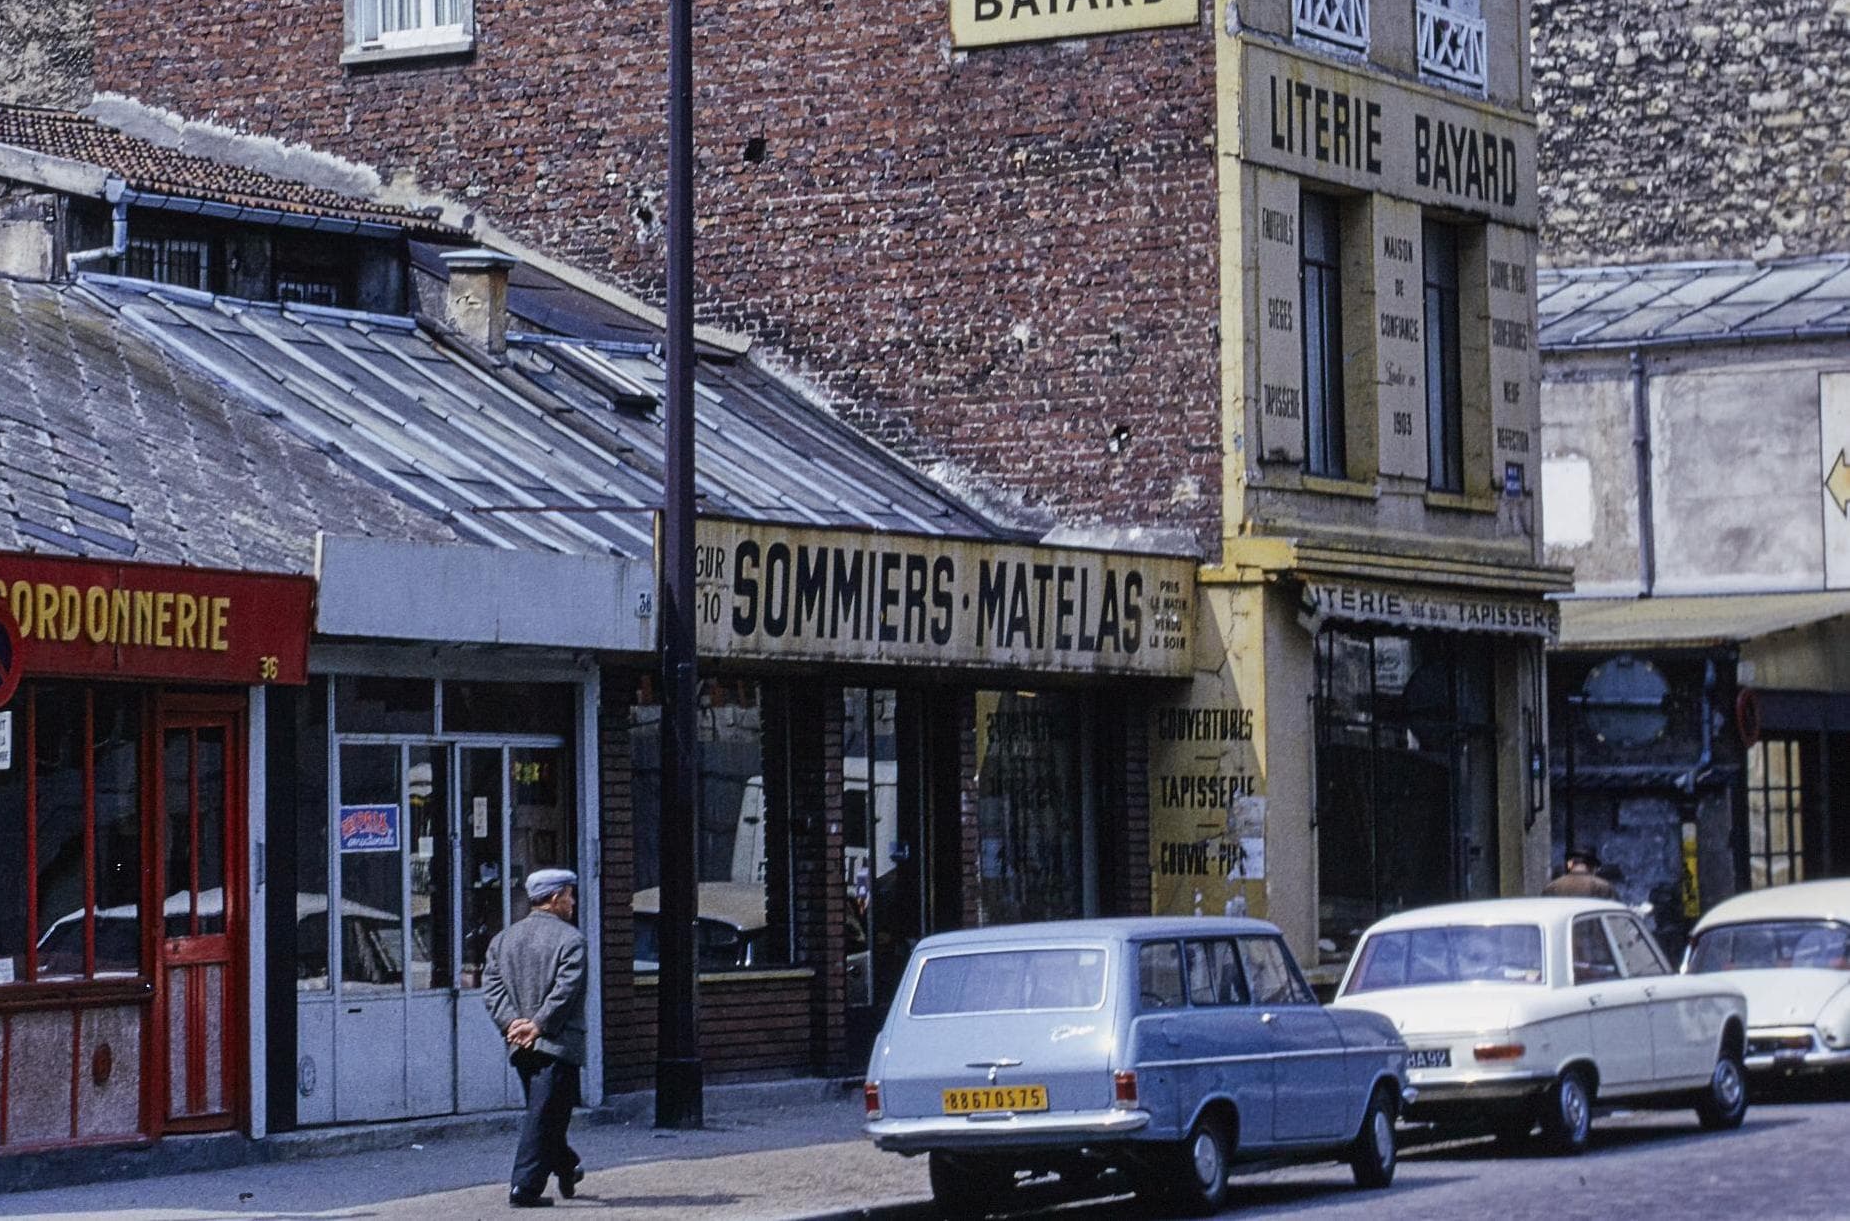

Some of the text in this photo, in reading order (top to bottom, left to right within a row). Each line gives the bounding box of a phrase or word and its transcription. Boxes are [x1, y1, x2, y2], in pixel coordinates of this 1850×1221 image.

[1269, 75, 1517, 207] LITERIE BAYARD
[1383, 235, 1413, 264] MAISON
[1395, 278, 1404, 297] DE
[1268, 297, 1293, 333] SIEGES
[1380, 312, 1419, 343] CONFIANCE
[1263, 383, 1301, 420] TAPISSERIE
[695, 544, 725, 579] GUR
[732, 540, 1143, 655] SOMMIERS MATELAS
[1159, 580, 1180, 593] PRIS
[697, 592, 721, 624] -10
[1149, 635, 1186, 650] LE SOIR
[259, 656, 279, 679] 36
[1157, 707, 1254, 741] COUVERTURES
[950, 1090, 991, 1110] 8867
[1020, 1088, 1040, 1106] 75
